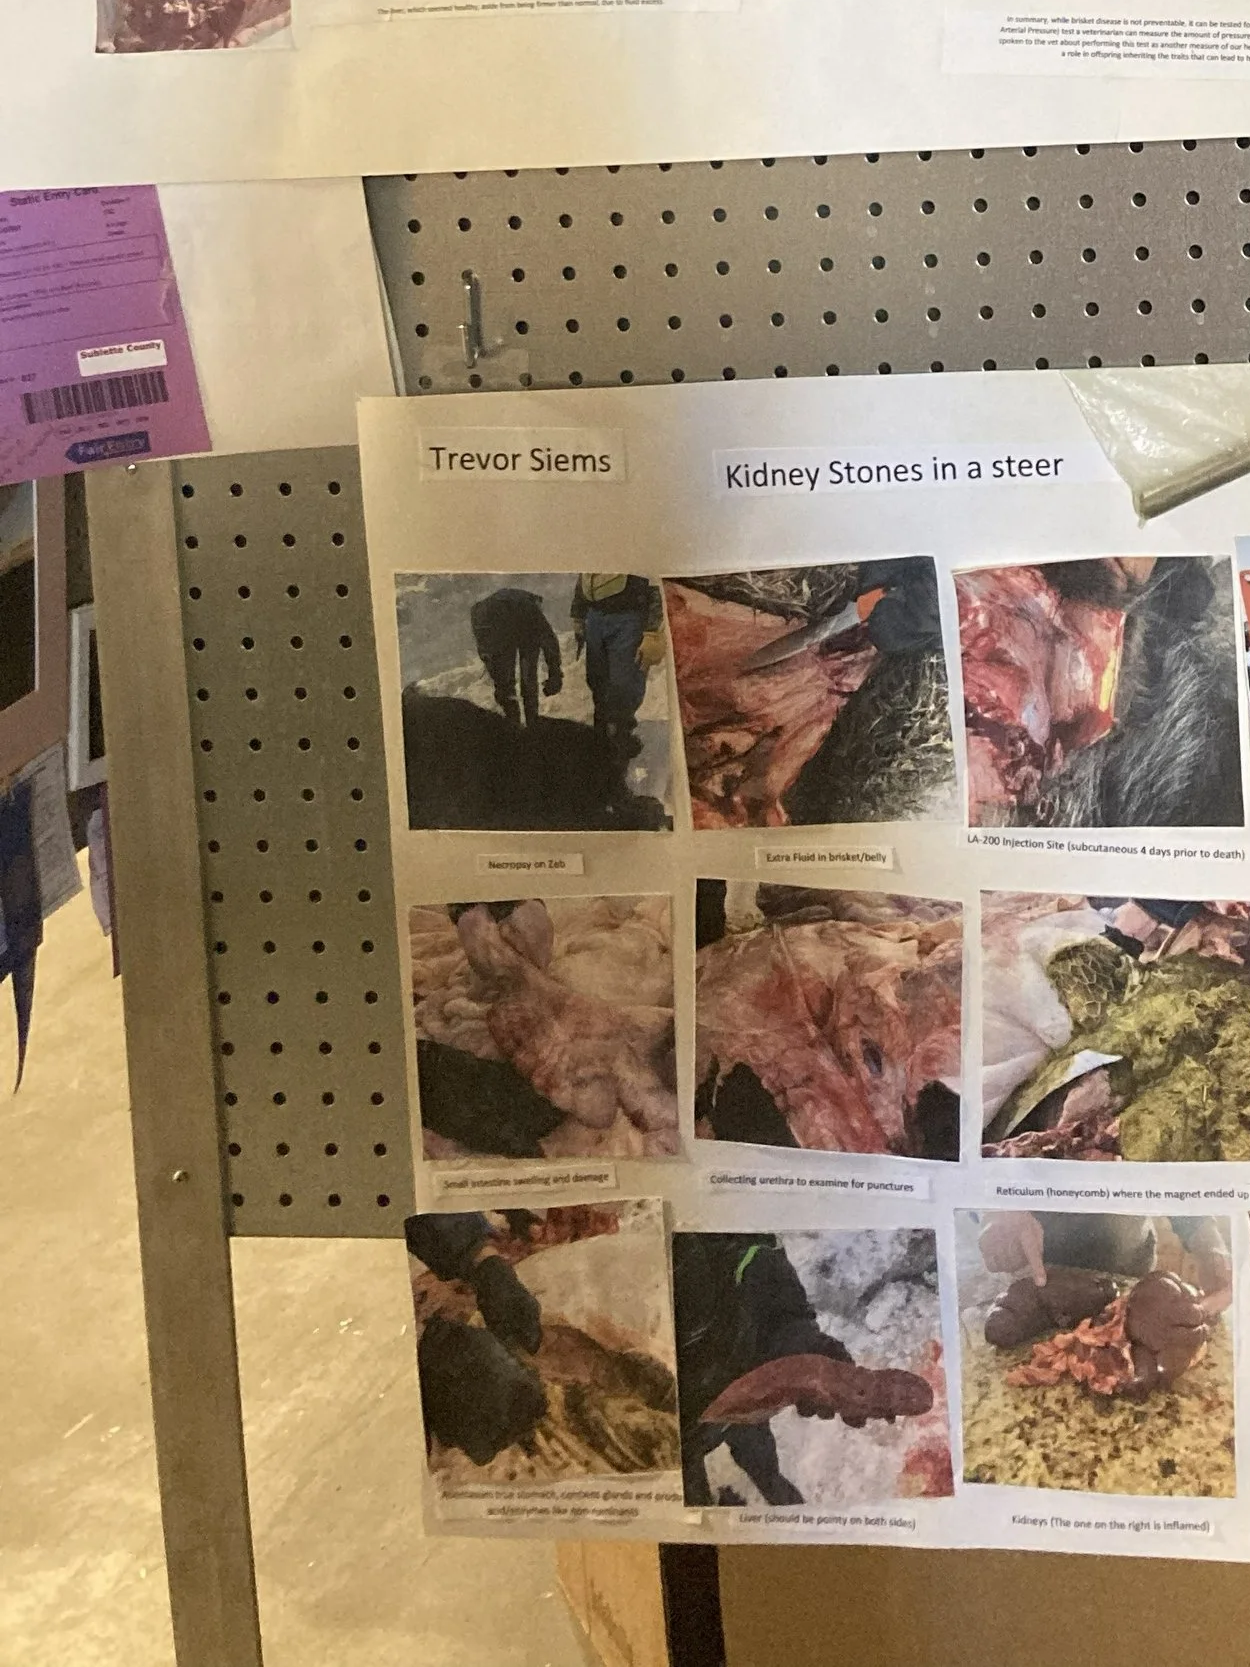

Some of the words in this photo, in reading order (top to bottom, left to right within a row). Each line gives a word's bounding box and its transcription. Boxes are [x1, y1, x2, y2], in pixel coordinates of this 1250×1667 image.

[80, 342, 124, 360] Sublette
[126, 340, 161, 353] County
[428, 446, 522, 471] Trevor
[530, 447, 612, 473] Siems
[726, 461, 820, 492] Kidney
[828, 460, 924, 485] Stones
[932, 456, 957, 481] in
[967, 461, 982, 480] a
[992, 455, 1064, 479] steer
[766, 853, 791, 863] Extra
[792, 852, 816, 862] Fluid
[817, 853, 827, 862] in
[828, 851, 887, 864] brisket/belly
[967, 834, 1001, 846] LA-200
[1002, 836, 1045, 849] Injection
[1046, 839, 1065, 851] Site
[1067, 840, 1139, 855] (subcutaneous
[1140, 845, 1147, 855] 4
[1148, 845, 1172, 859] days
[1173, 848, 1198, 859] prior
[1199, 849, 1211, 859] to
[1212, 848, 1246, 862] death)
[709, 1174, 757, 1187] Collecting
[758, 1175, 795, 1186] urethra
[795, 1177, 807, 1187] to
[808, 1178, 850, 1189] examine
[850, 1178, 866, 1189] for
[866, 1181, 915, 1193] punctures
[996, 1186, 1045, 1197] Reticulum
[1046, 1187, 1111, 1200] (honeycomb)
[1111, 1189, 1143, 1199] where
[1144, 1189, 1162, 1199] the
[1163, 1190, 1202, 1202] magnet
[1203, 1188, 1235, 1199] ended
[1237, 1191, 1250, 1201] up
